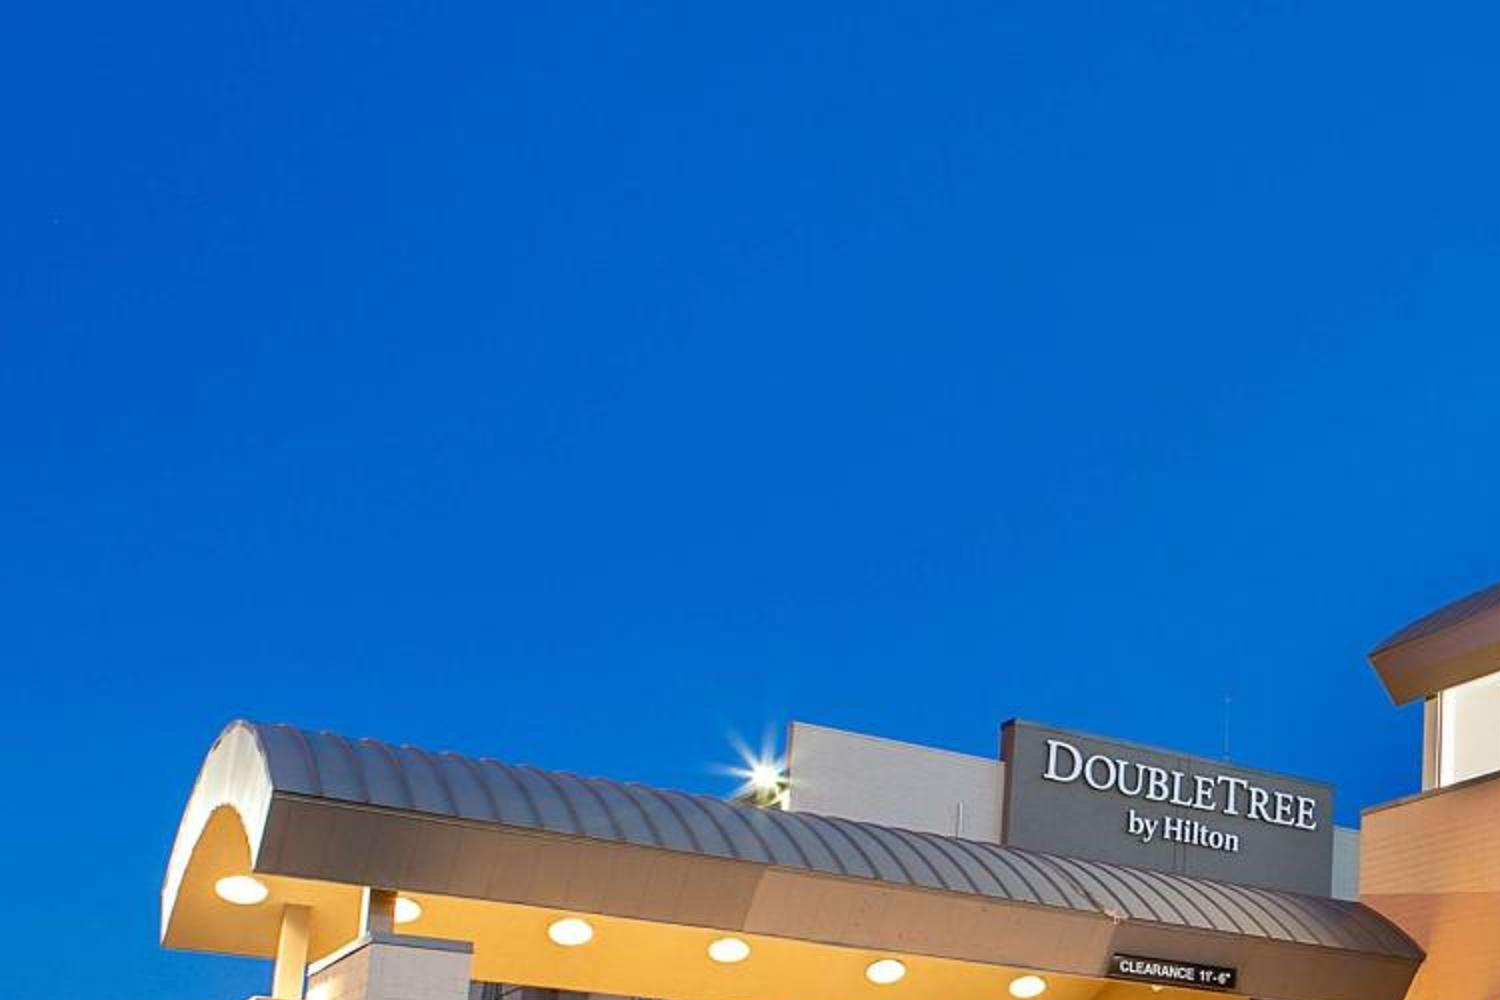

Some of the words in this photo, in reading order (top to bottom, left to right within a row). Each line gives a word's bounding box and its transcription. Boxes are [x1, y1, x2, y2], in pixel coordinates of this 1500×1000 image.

[1043, 739, 1318, 831] DOUBLETREE
[1128, 809, 1159, 843] by
[1163, 816, 1239, 852] Hilton
[1119, 959, 1196, 981] CLEARANCE
